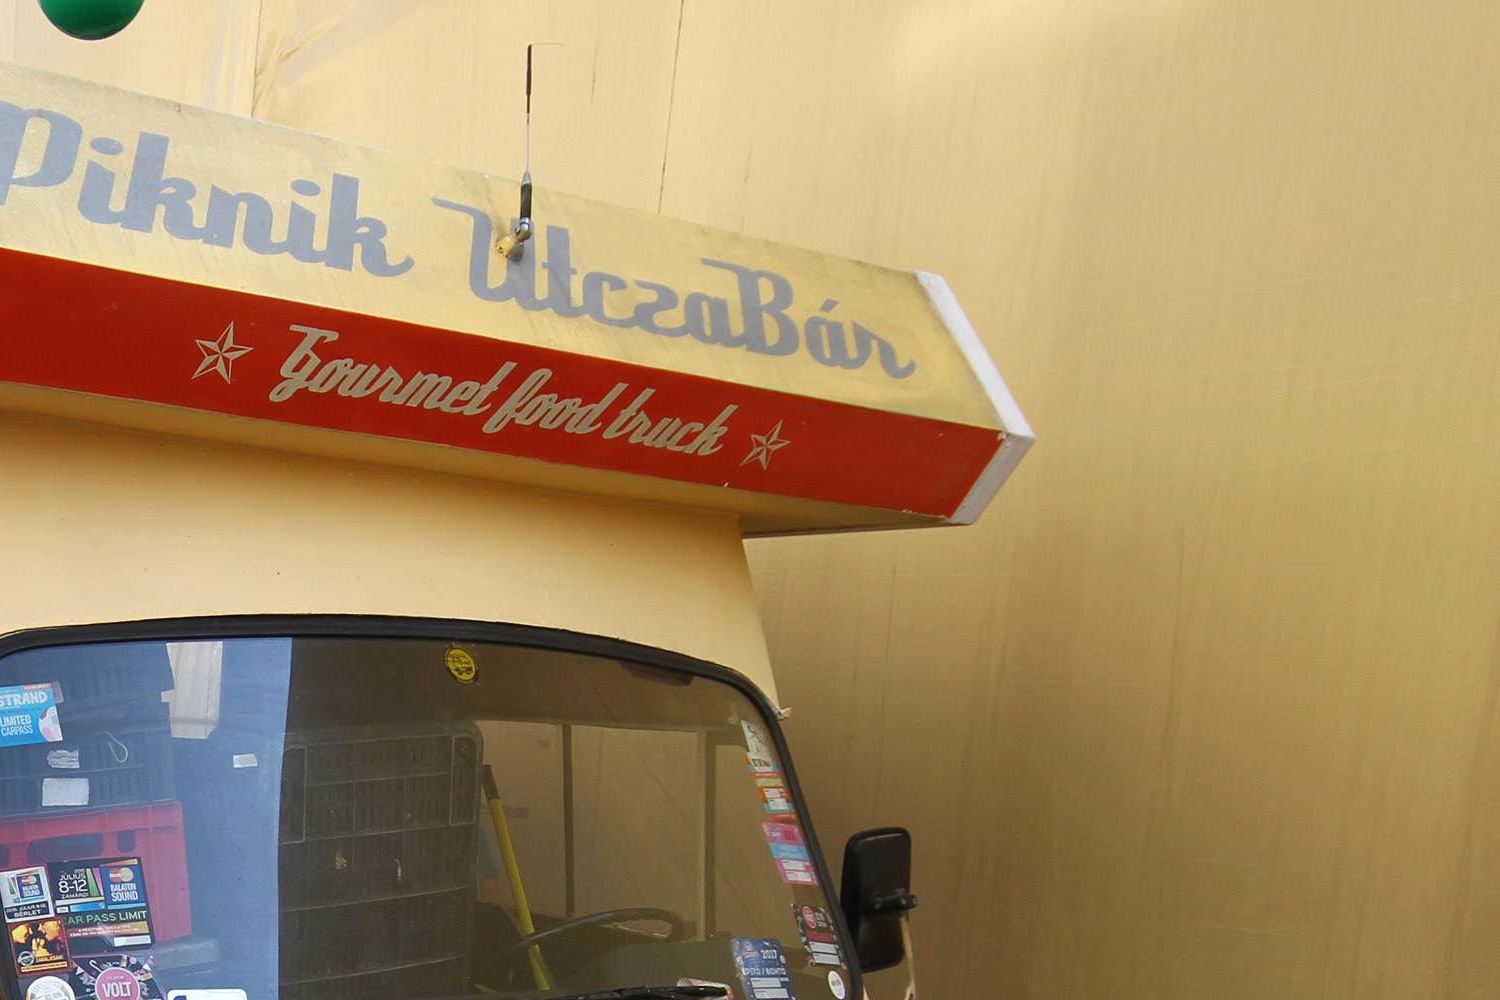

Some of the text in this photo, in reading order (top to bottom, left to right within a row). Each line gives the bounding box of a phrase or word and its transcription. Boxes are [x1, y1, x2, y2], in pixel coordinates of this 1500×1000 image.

[269, 323, 739, 456] Gourmet food truck
[0, 714, 31, 727] LIMITED
[1, 725, 33, 736] CARPASS
[58, 880, 88, 893] 8-12
[110, 882, 137, 892] BALATON
[111, 890, 139, 902] SOUND
[86, 913, 117, 923] PASS
[119, 910, 148, 921] LIMIT
[760, 949, 777, 959] 2017
[101, 982, 131, 998] VOLT
